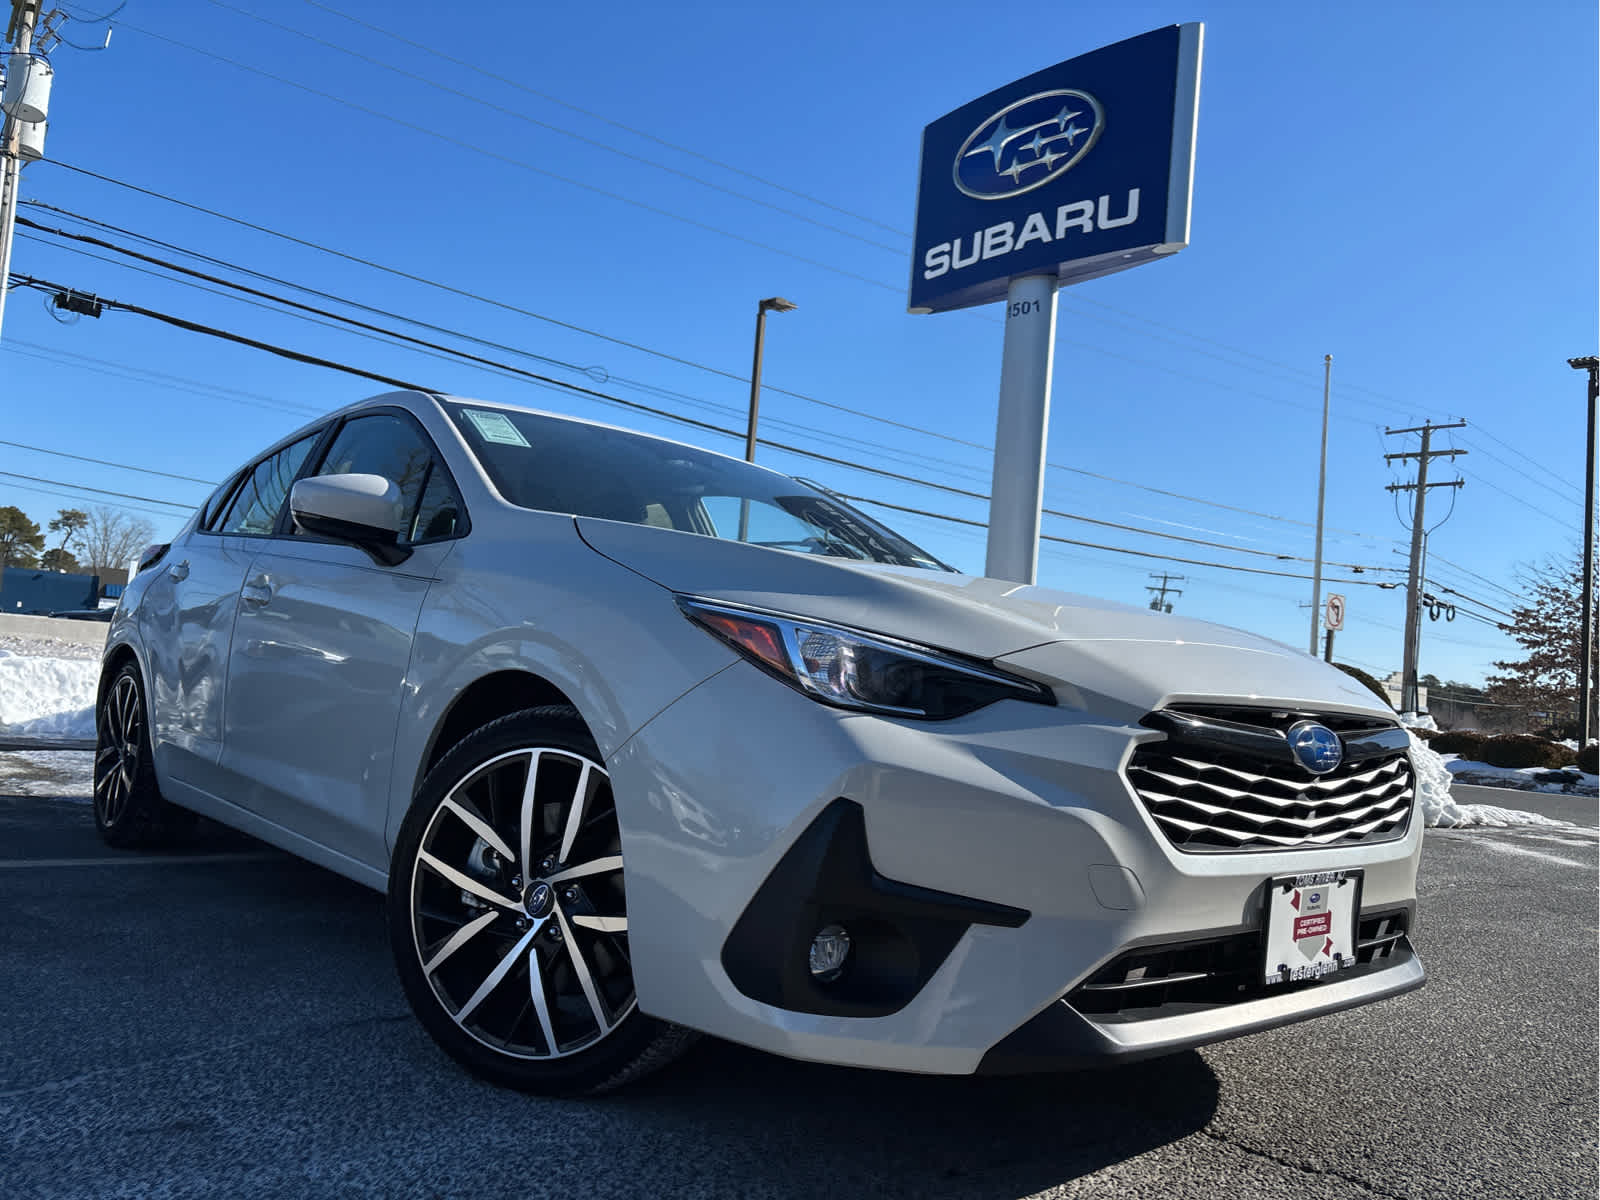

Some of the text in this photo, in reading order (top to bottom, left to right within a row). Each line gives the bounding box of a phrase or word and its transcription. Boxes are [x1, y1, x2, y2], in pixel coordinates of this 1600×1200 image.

[923, 188, 1140, 280] SUBARU
[1008, 300, 1041, 318] 1501
[1300, 917, 1326, 927] CERTIFIED
[1296, 925, 1328, 935] PRE-OWNED
